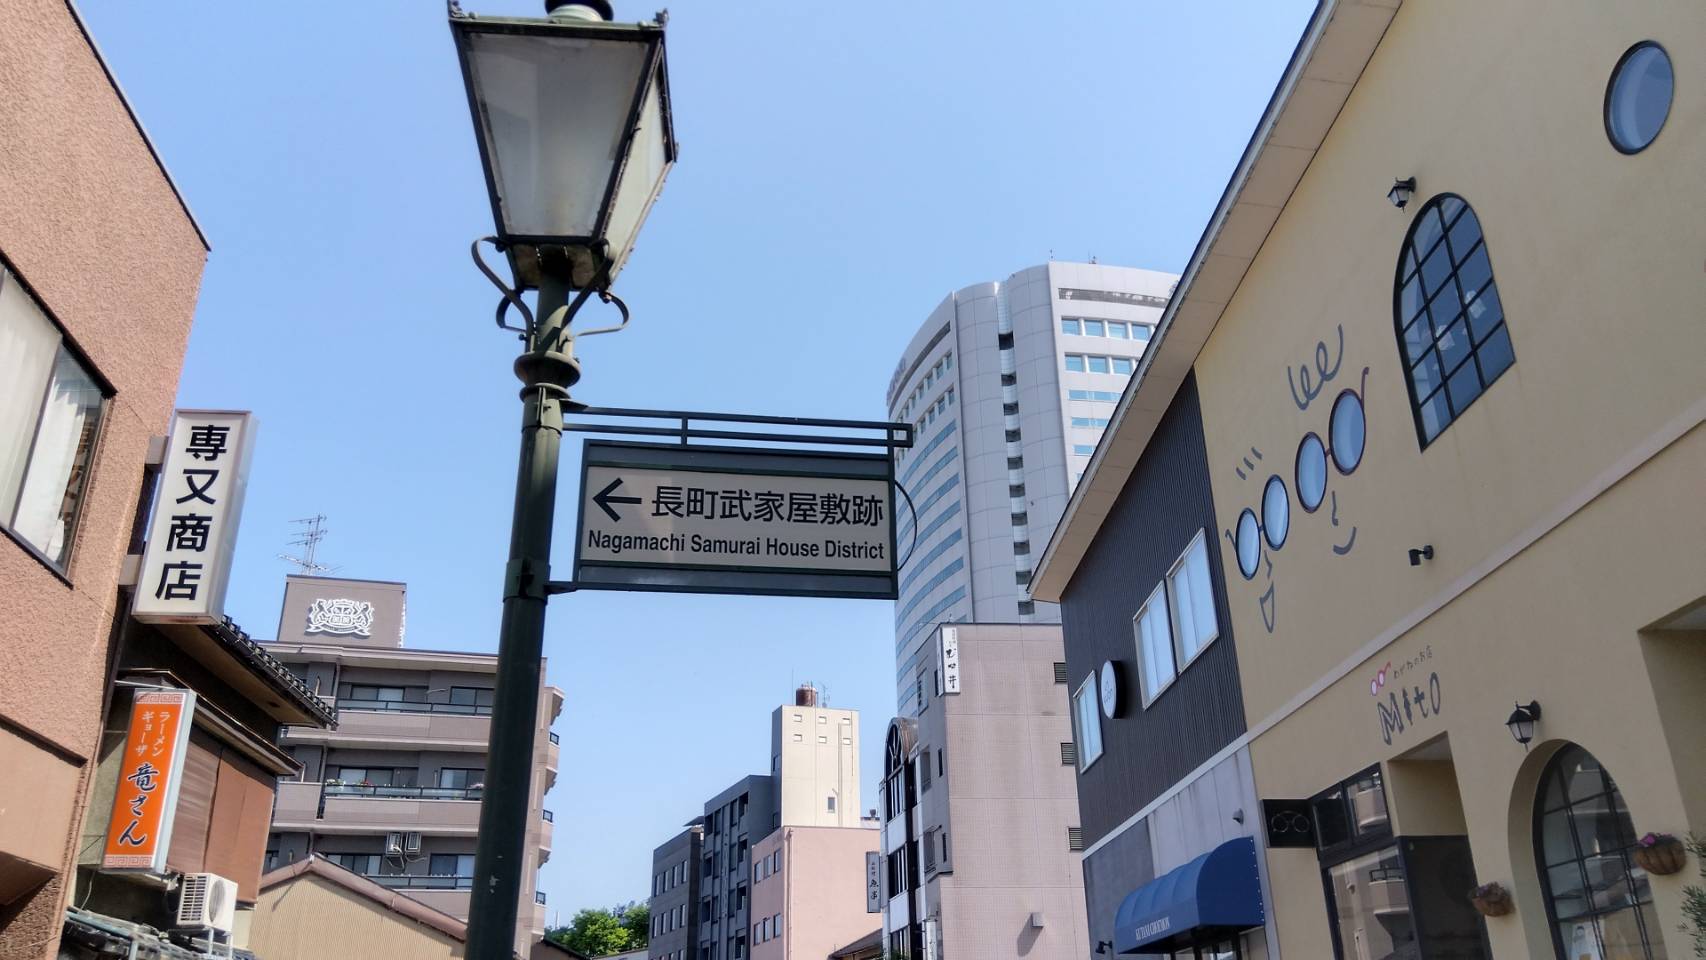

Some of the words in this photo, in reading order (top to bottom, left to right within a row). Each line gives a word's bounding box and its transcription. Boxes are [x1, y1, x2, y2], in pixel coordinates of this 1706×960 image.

[155, 424, 231, 601] 専又商店
[651, 485, 883, 527] 長町武家屋敷跡
[588, 529, 685, 553] Nagamachi
[691, 533, 761, 556] Samurai
[766, 537, 819, 557] House
[825, 539, 884, 560] District
[135, 711, 155, 757] ギョーザ
[152, 711, 171, 757] ラーメン
[118, 762, 160, 846] 竜さん
